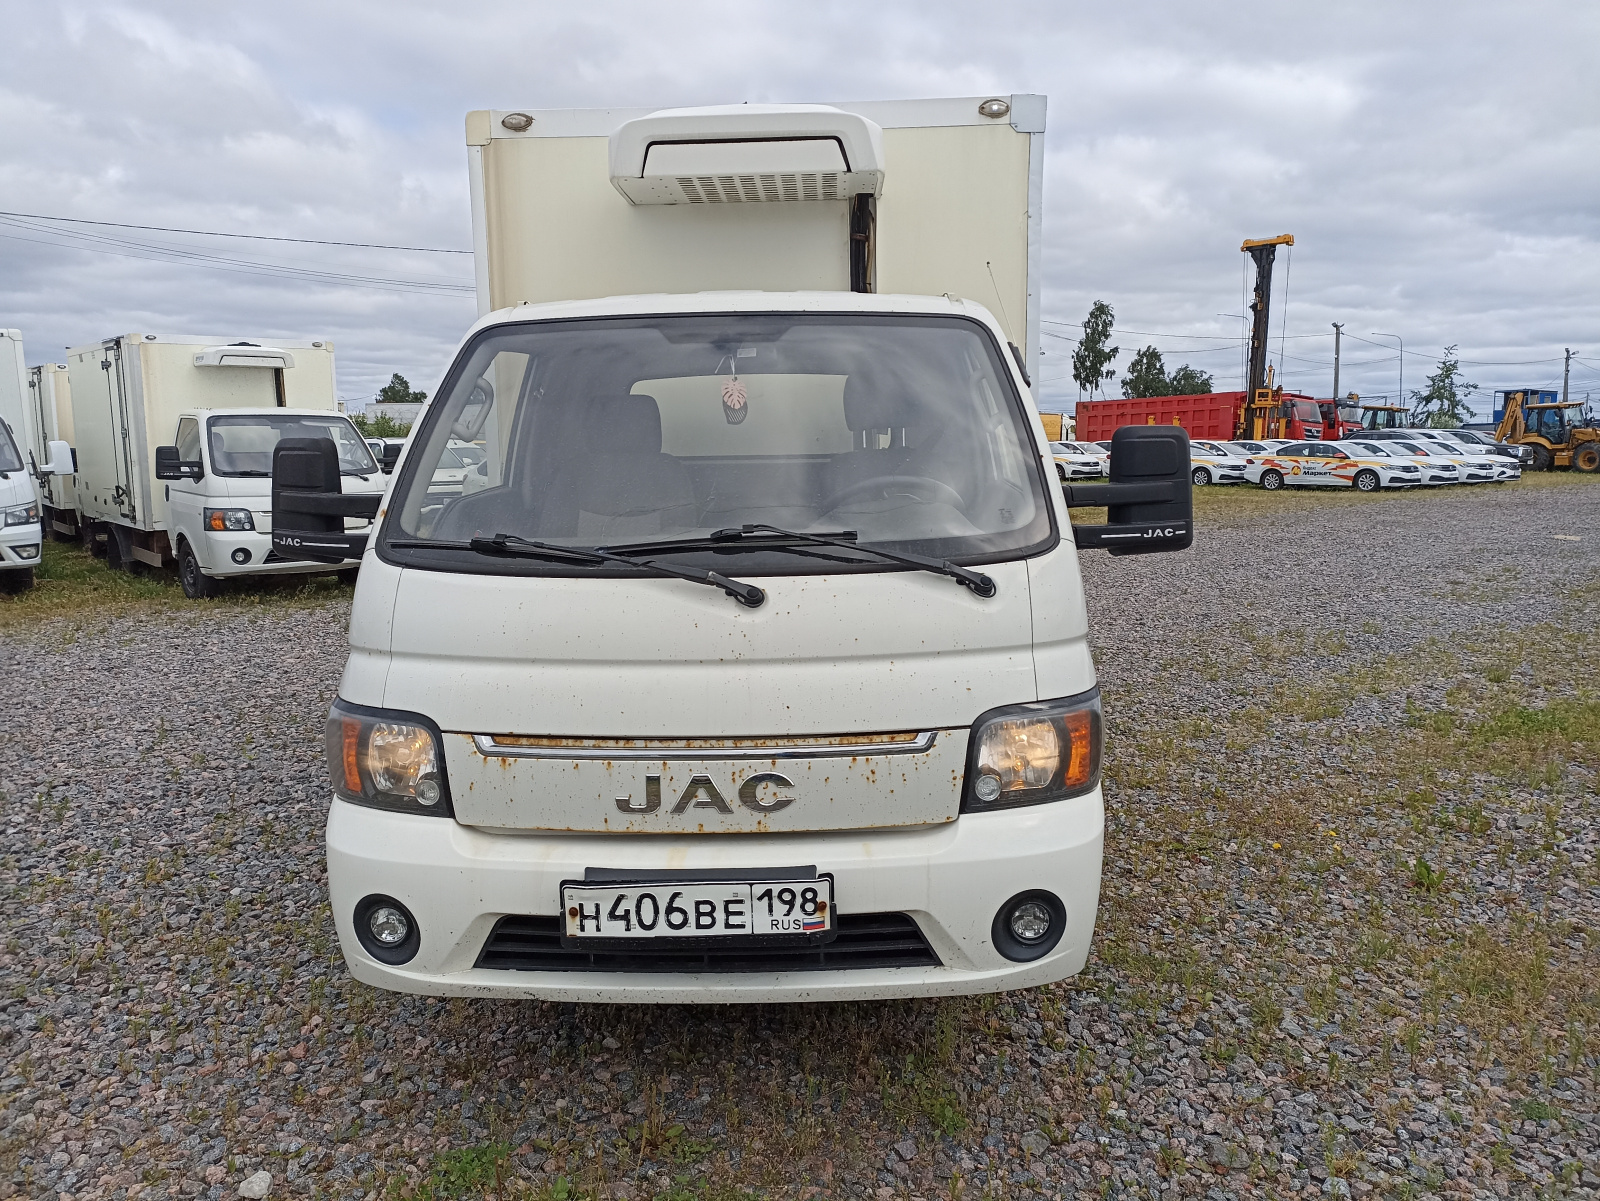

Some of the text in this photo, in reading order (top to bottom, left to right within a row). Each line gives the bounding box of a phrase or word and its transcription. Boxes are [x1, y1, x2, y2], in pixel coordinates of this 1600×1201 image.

[1143, 528, 1174, 538] JAC
[280, 536, 301, 547] JAC
[615, 771, 796, 814] JAC
[756, 886, 819, 917] 198
[770, 919, 801, 930] RUS
